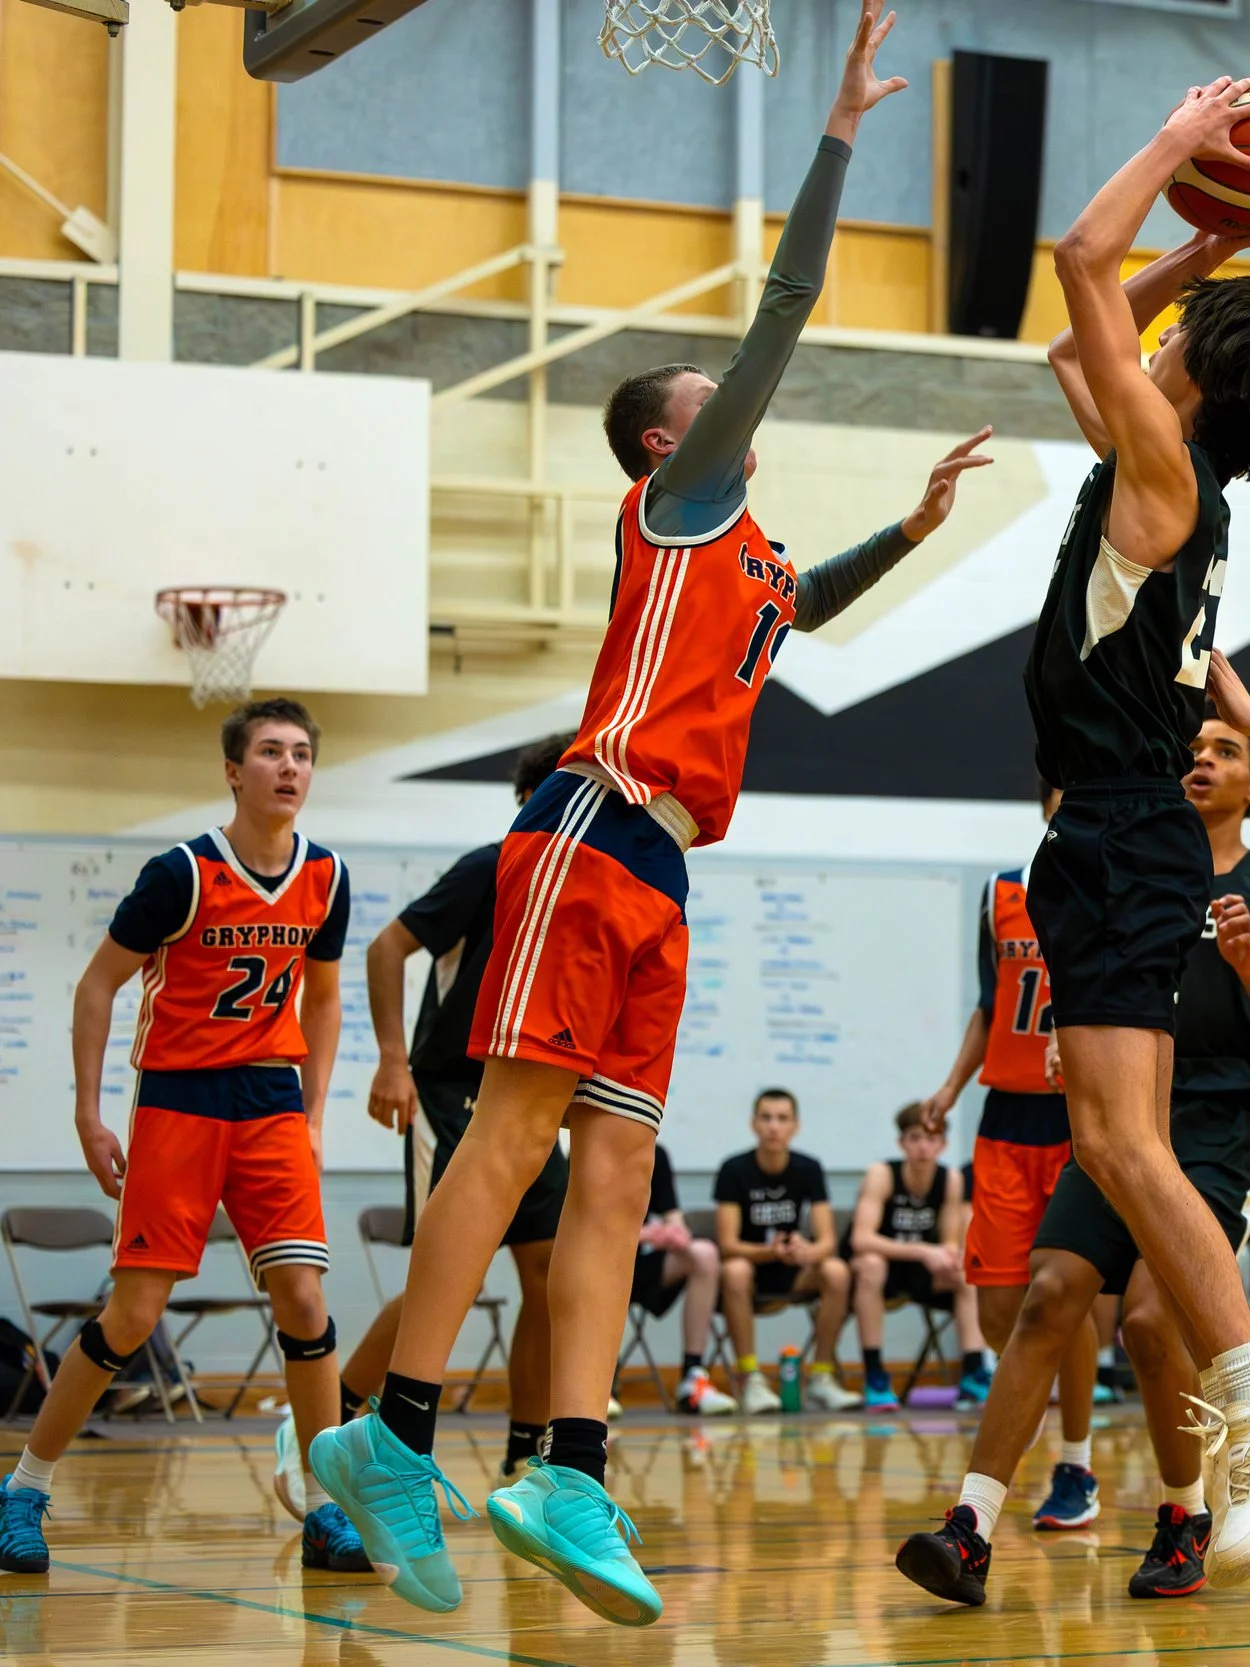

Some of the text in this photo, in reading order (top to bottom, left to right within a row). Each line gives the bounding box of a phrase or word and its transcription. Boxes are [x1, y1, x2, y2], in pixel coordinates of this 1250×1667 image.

[200, 923, 319, 948] GRYPHON
[209, 954, 301, 1021] 24
[547, 1038, 577, 1050] adidas
